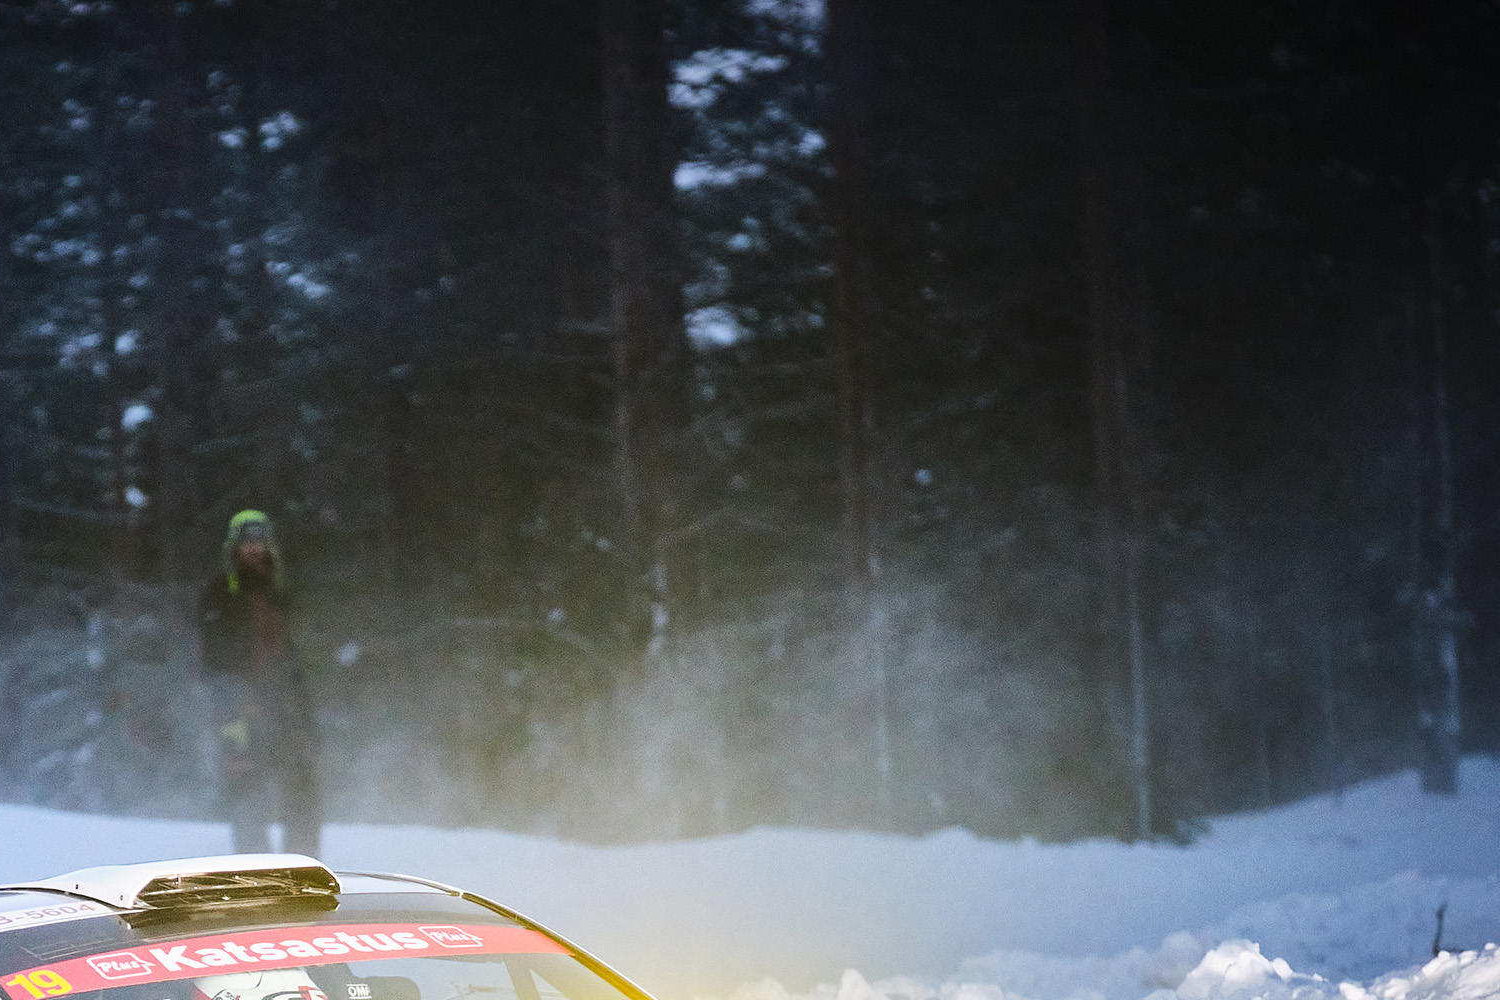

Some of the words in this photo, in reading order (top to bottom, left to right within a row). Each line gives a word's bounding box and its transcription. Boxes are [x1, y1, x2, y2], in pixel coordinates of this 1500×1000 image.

[96, 960, 140, 973] Plus
[148, 929, 429, 972] Katsastus
[6, 970, 73, 999] 19
